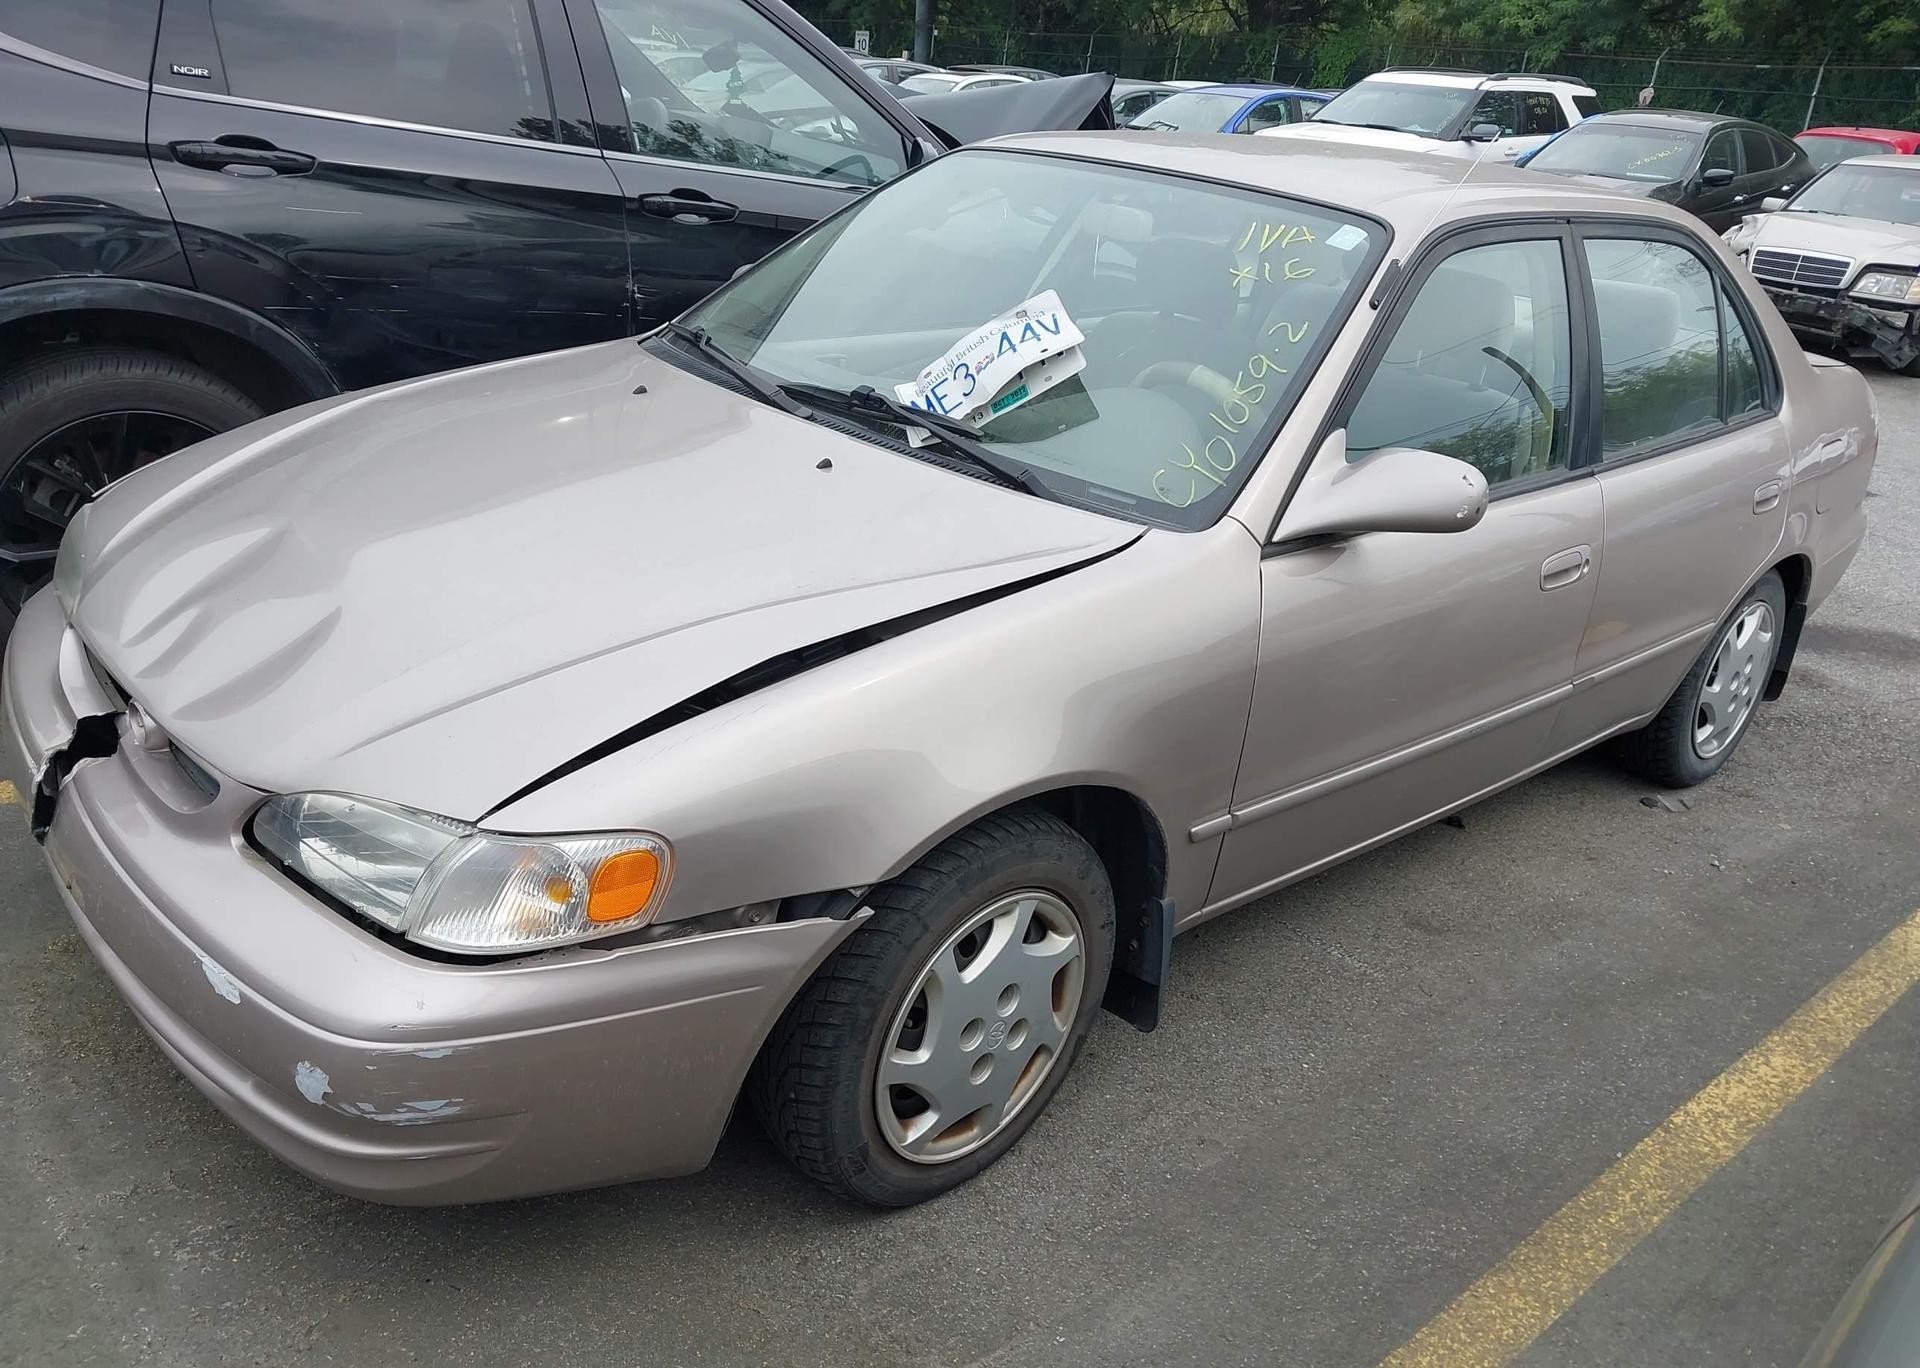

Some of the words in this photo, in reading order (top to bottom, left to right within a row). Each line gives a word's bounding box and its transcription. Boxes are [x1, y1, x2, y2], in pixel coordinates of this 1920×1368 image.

[856, 38, 867, 51] 10
[173, 65, 209, 76] NOIR
[996, 313, 1061, 358] 44V
[914, 358, 956, 397] Beautiful
[956, 333, 989, 361] British
[989, 310, 1046, 336] Columbia
[993, 398, 1005, 409] OCT
[972, 411, 984, 423] 13
